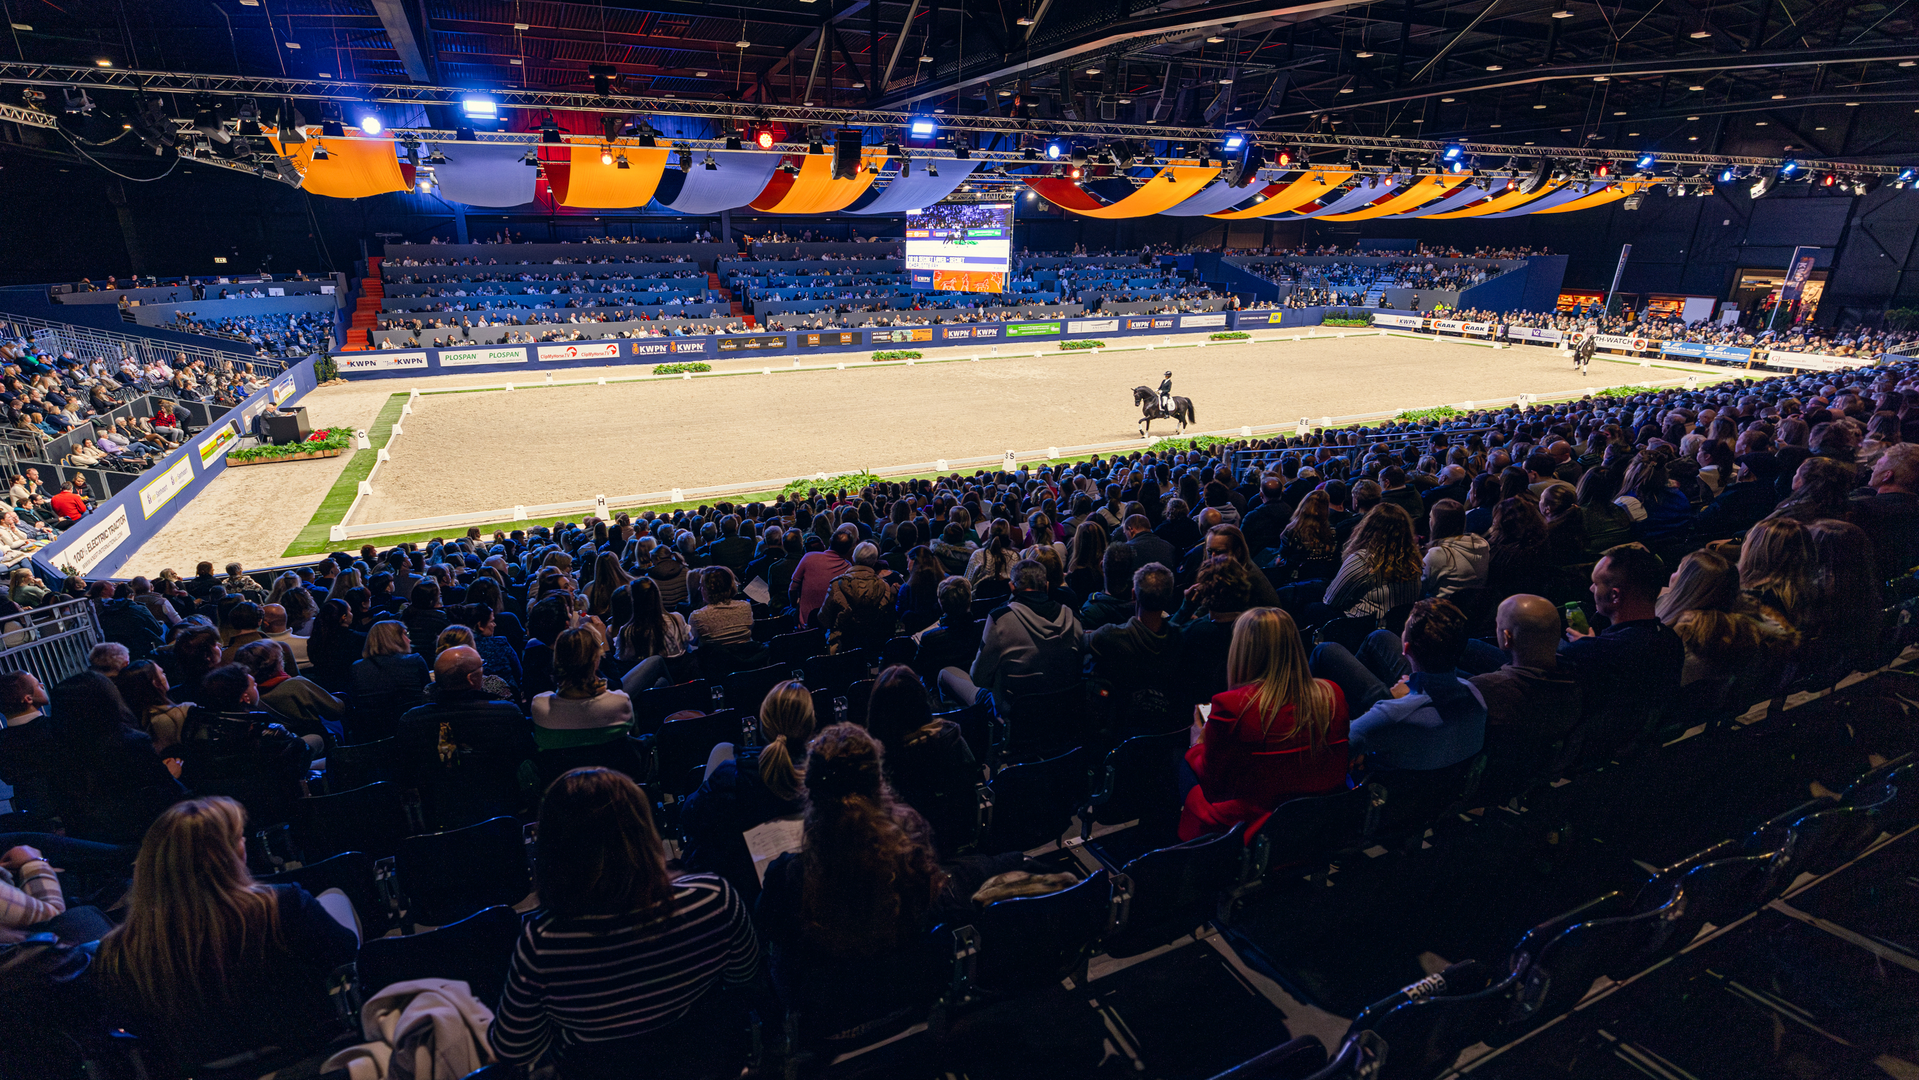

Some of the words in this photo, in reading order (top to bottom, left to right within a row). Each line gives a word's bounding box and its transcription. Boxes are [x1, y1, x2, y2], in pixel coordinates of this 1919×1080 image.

[1595, 335, 1634, 345] TH-WATCH
[640, 345, 668, 353] KWPN
[677, 343, 705, 351] KWPN
[445, 353, 477, 361] PLOSPAN
[350, 359, 377, 367] KWPN
[597, 498, 605, 506] H
[86, 529, 109, 553] ELECTRIC
[107, 514, 126, 535] TRACTOR
